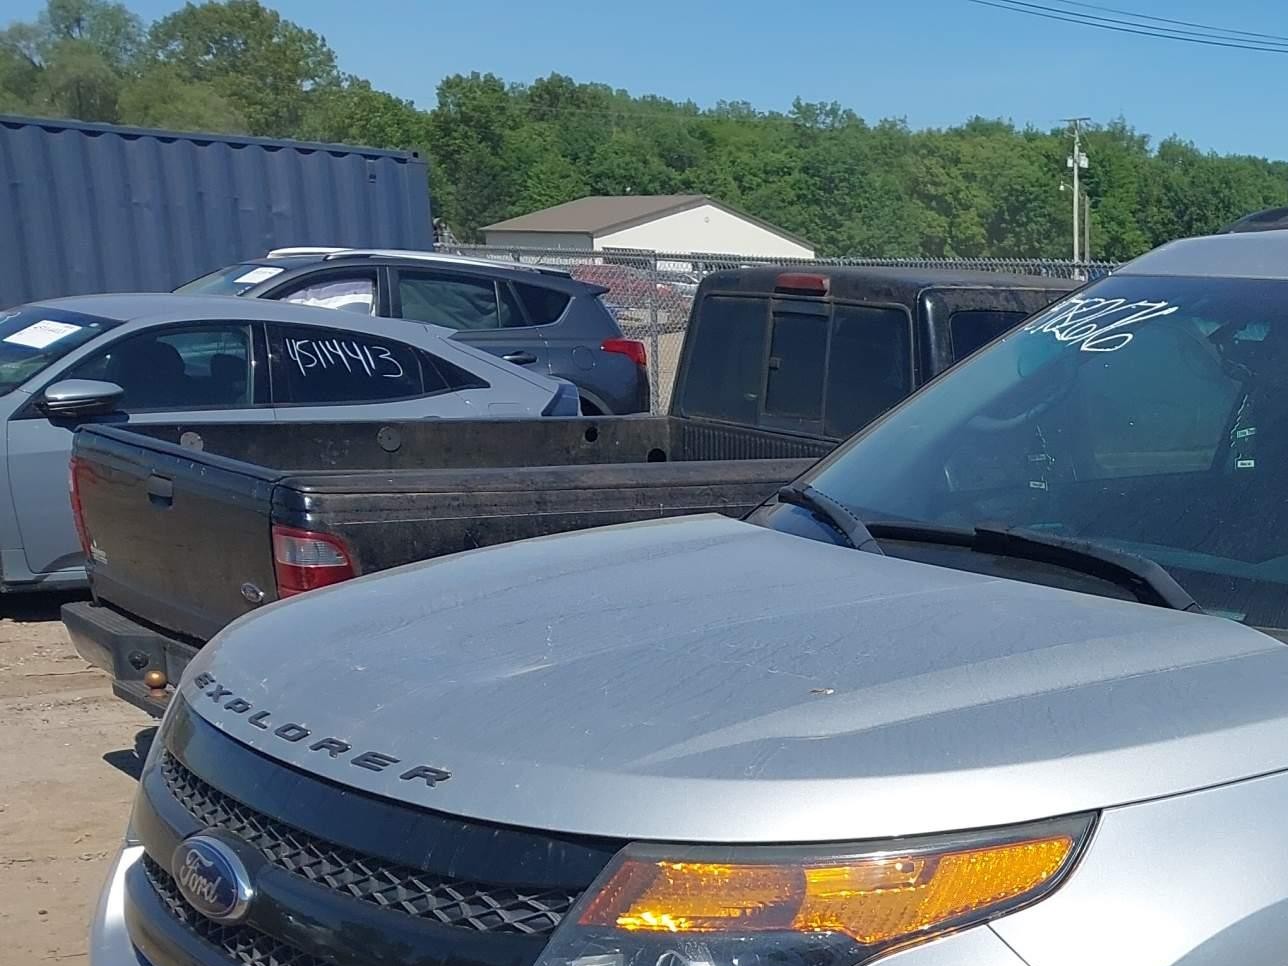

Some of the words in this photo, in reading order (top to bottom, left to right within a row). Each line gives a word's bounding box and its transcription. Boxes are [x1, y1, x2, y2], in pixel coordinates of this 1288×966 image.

[285, 338, 403, 377] 45114413
[194, 671, 452, 788] EXPLORER
[180, 848, 223, 904] Ford
